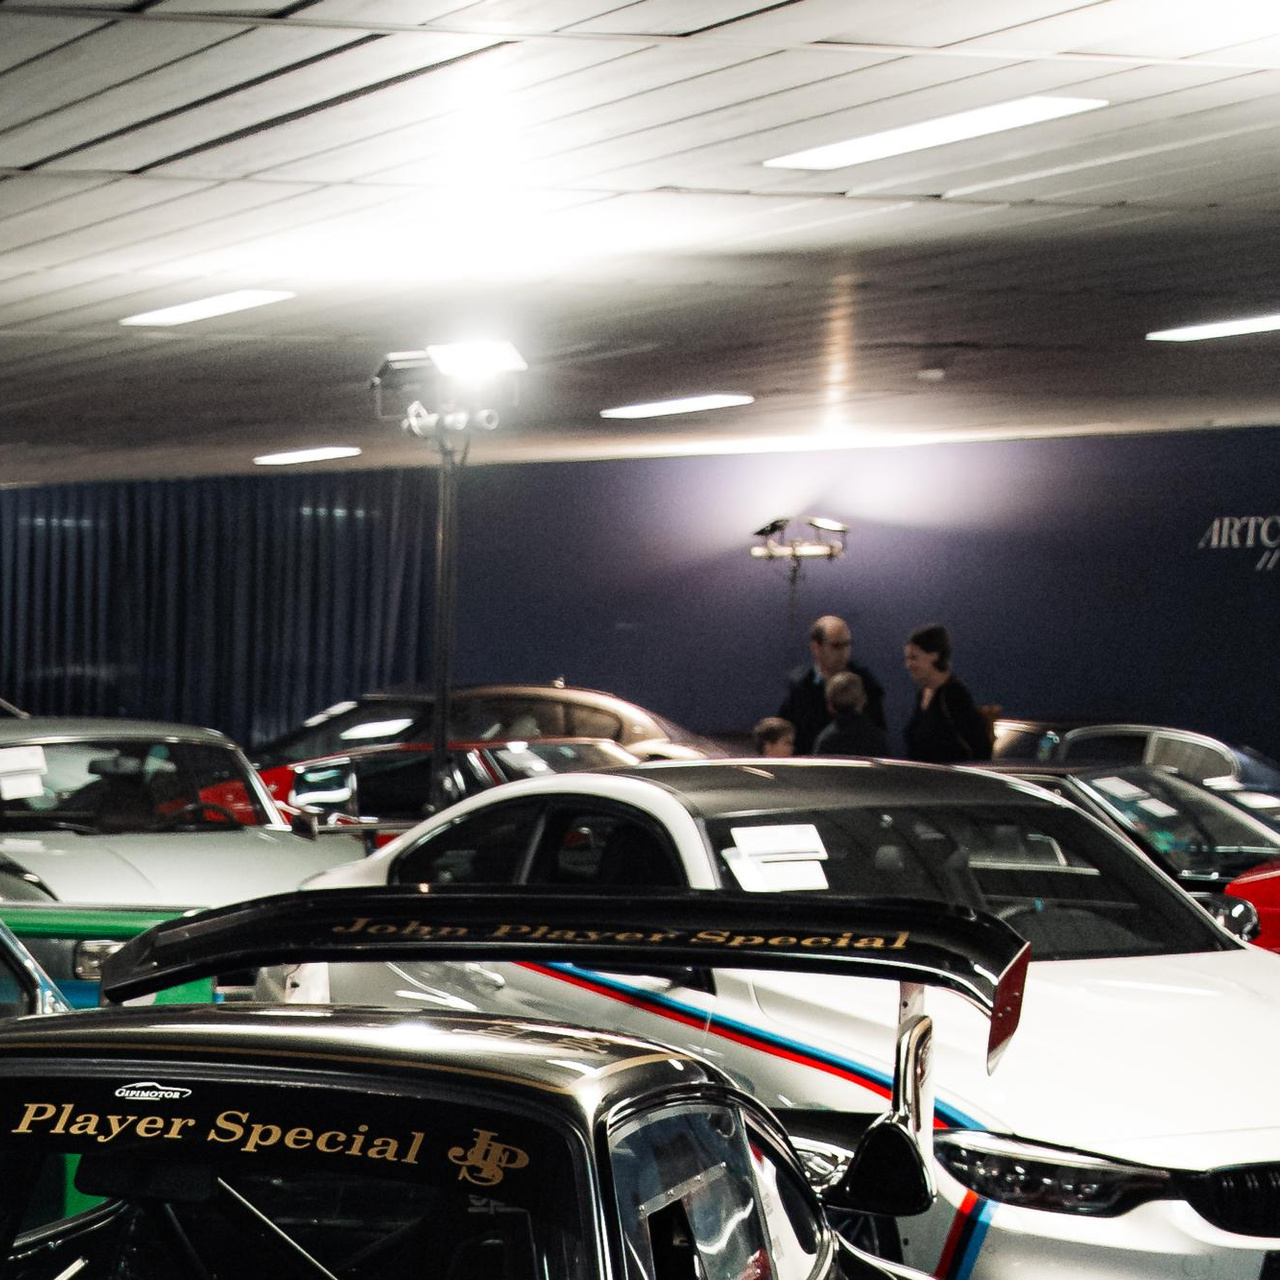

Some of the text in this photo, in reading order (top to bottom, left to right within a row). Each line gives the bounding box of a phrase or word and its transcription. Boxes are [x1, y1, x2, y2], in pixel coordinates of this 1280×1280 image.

[332, 917, 909, 950] John Player Special
[115, 1088, 181, 1099] GIPIMOTOR
[11, 1102, 199, 1145] Player
[206, 1110, 425, 1164] Special
